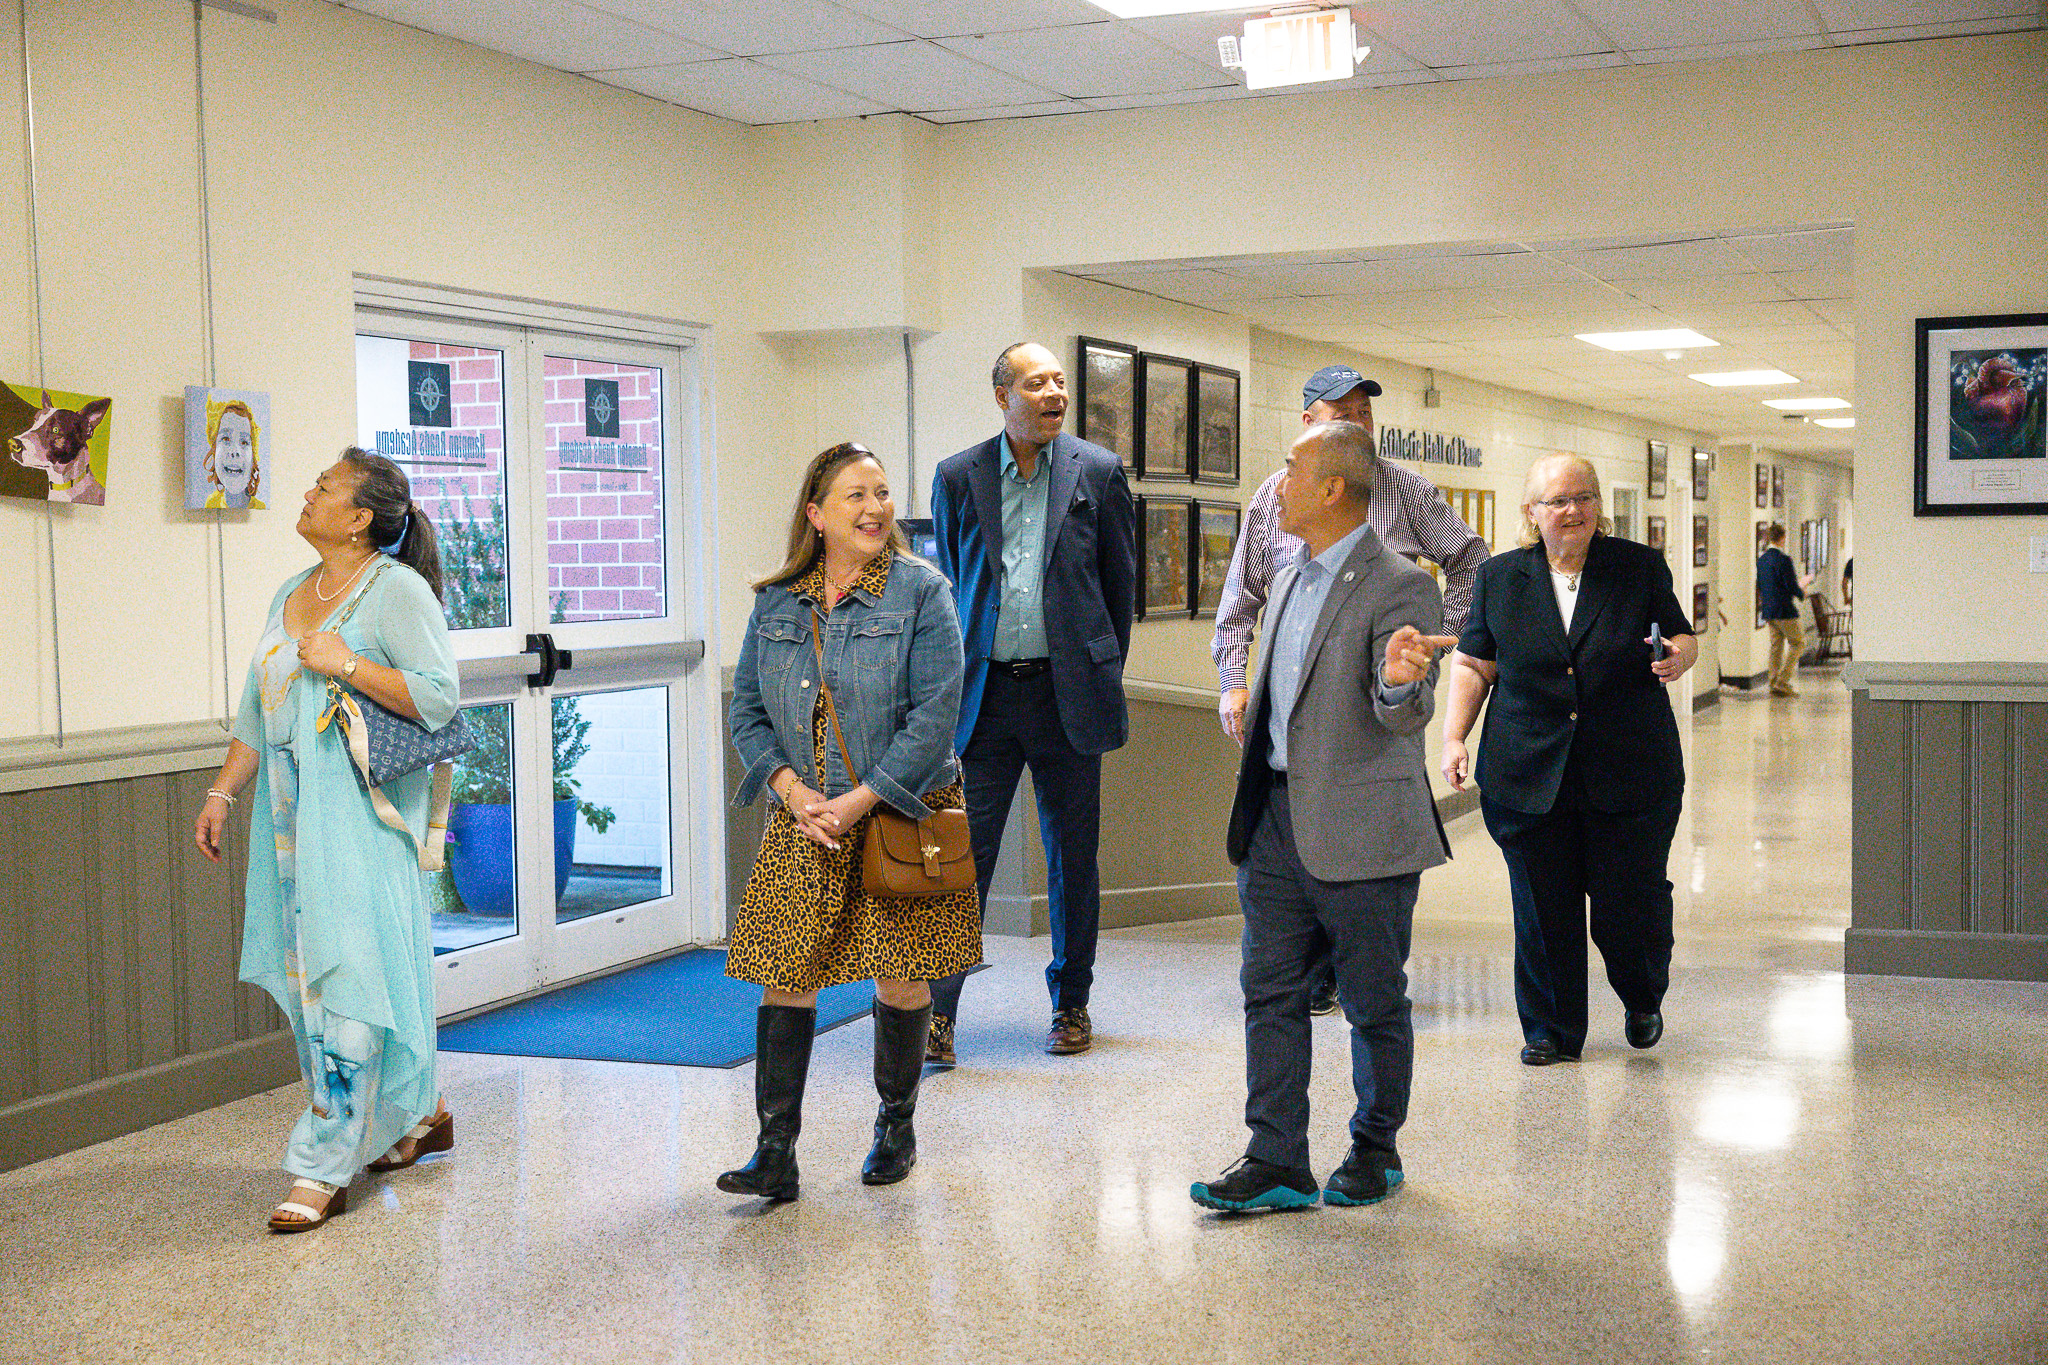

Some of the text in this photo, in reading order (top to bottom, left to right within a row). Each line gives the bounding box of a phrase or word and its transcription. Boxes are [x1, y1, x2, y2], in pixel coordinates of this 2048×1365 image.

[1264, 14, 1336, 73] EXIT
[1378, 425, 1483, 468] Athletic Hall of Fame
